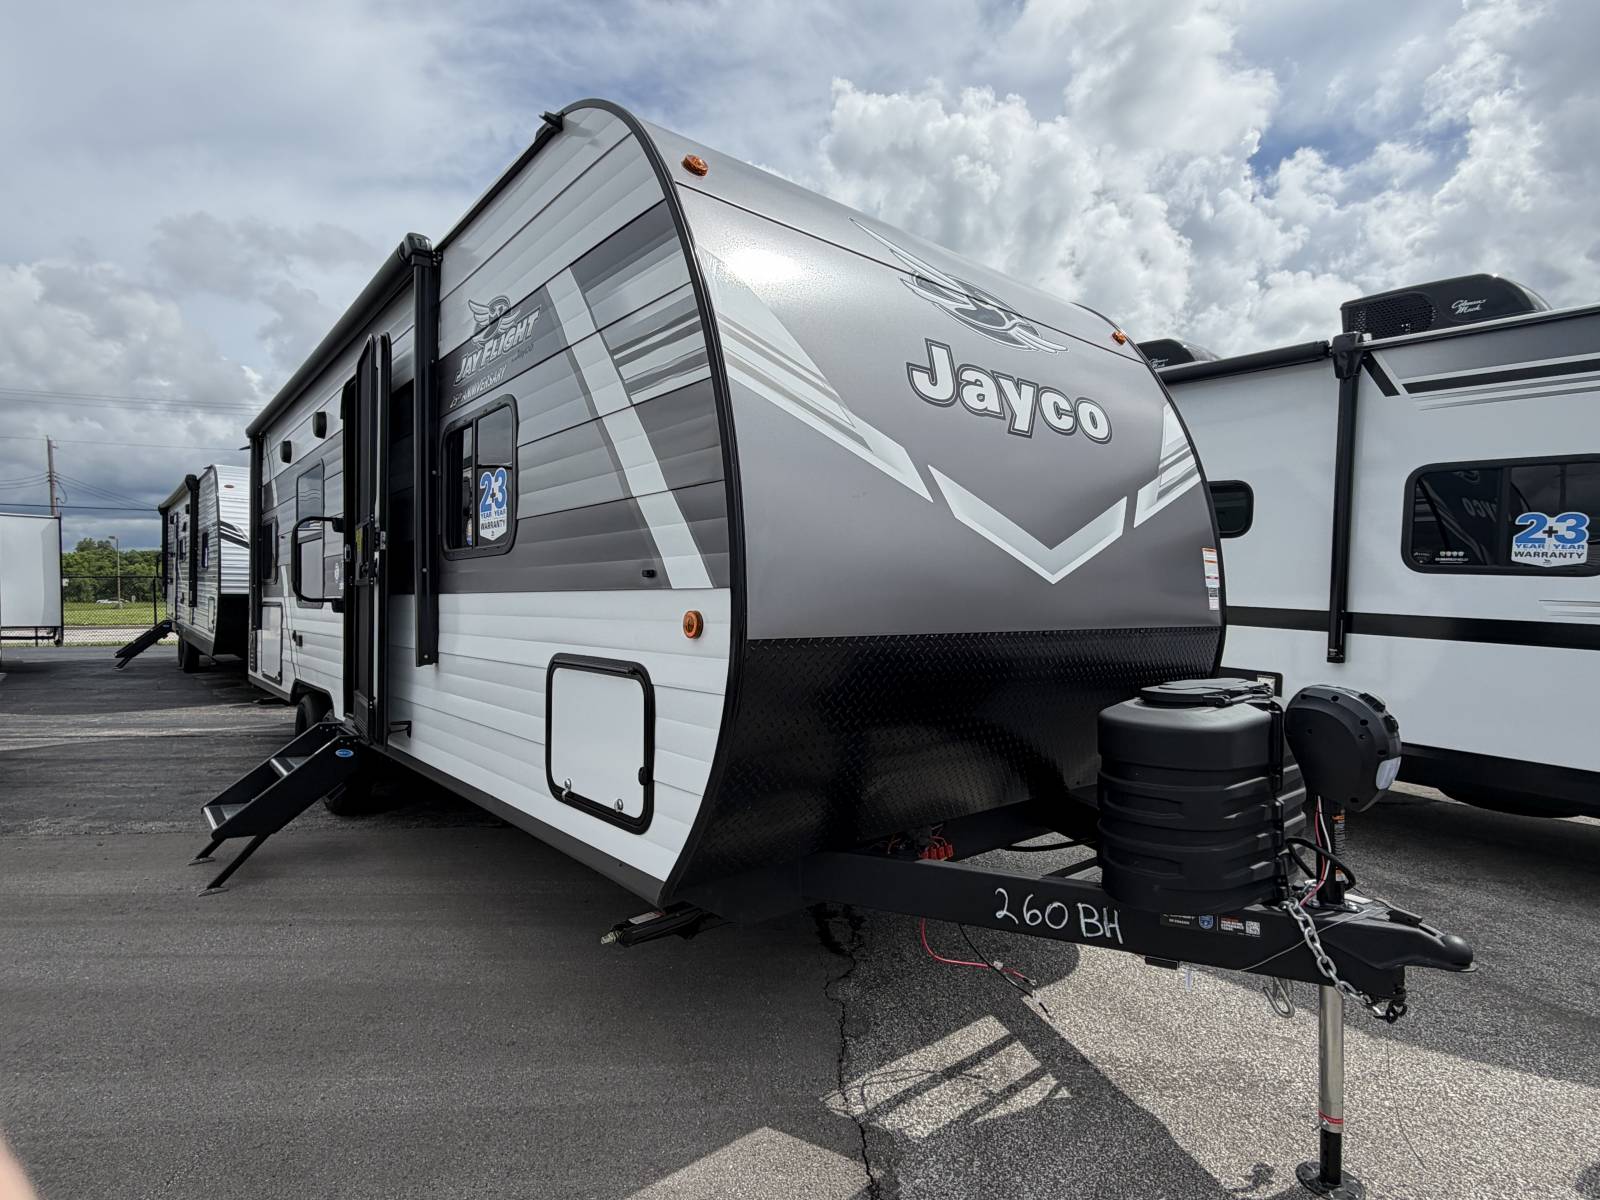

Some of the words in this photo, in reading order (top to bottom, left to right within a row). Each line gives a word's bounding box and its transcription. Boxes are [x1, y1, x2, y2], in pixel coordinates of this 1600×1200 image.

[454, 348, 483, 385] JAY
[480, 309, 541, 368] FLIGHT
[906, 338, 1112, 444] Jayco
[481, 511, 491, 519] YEAR
[494, 508, 506, 518] YEAR
[480, 519, 506, 531] WARRANTY
[1514, 550, 1585, 559] WARRANTY
